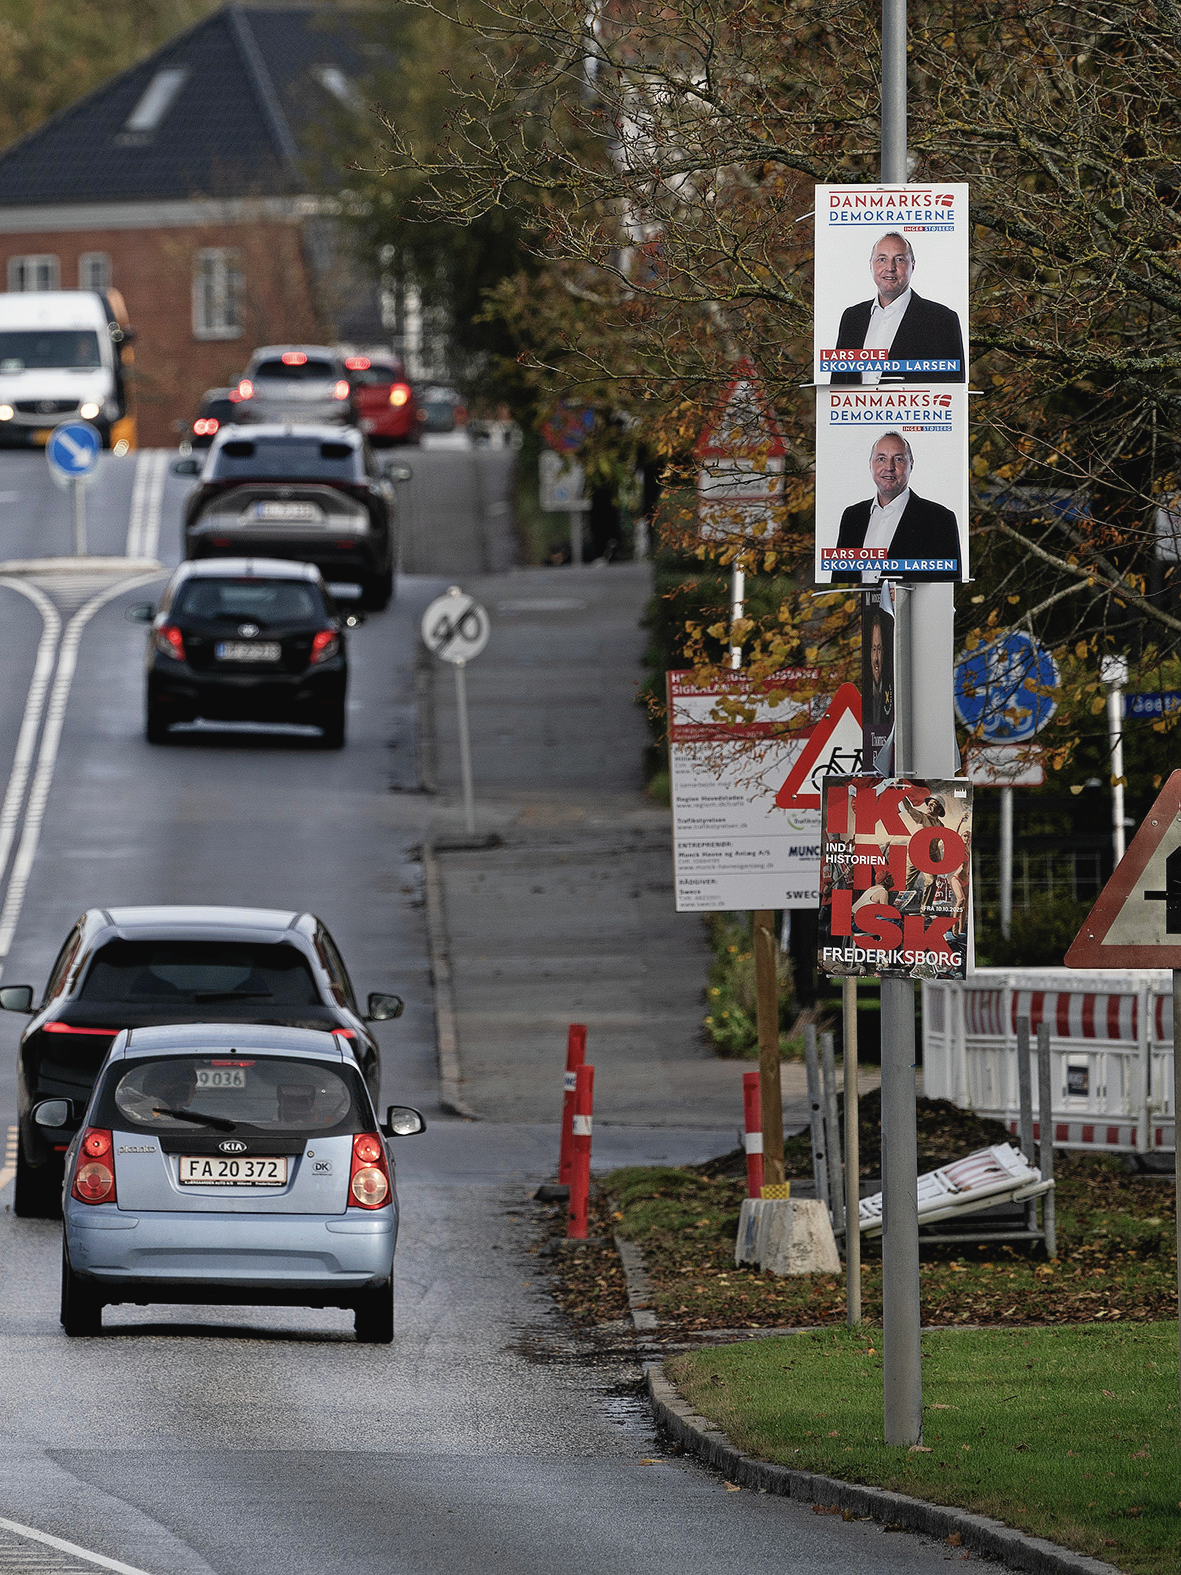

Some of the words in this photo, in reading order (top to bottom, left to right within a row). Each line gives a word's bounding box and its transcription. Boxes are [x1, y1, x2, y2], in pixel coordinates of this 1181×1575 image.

[829, 194, 932, 208] DANMARKS
[829, 210, 955, 222] DEMOKRATERNE
[822, 351, 855, 360] LARS
[859, 350, 887, 360] OLE
[822, 361, 901, 371] SKOVGAARD
[906, 360, 958, 371] LARSEN
[830, 394, 931, 408] DANMARKS
[830, 410, 953, 421] DEMOKRATERNE
[823, 549, 855, 559] LARS
[859, 549, 886, 559] OLE
[823, 560, 899, 570] SKOVGAARD
[904, 560, 955, 570] LARSEN
[788, 845, 820, 857] MUNC
[825, 842, 847, 853] IND
[848, 843, 853, 853] I
[825, 854, 886, 865] HISTORIEN
[786, 890, 819, 900] SWEC
[823, 947, 962, 967] FREDERIKSBORG
[212, 1071, 243, 1087] 036
[117, 1145, 157, 1156] picanto
[223, 1142, 244, 1151] KIA
[190, 1160, 213, 1177] FA
[218, 1161, 240, 1177] 20
[244, 1161, 278, 1178] 372
[315, 1162, 329, 1171] DK
